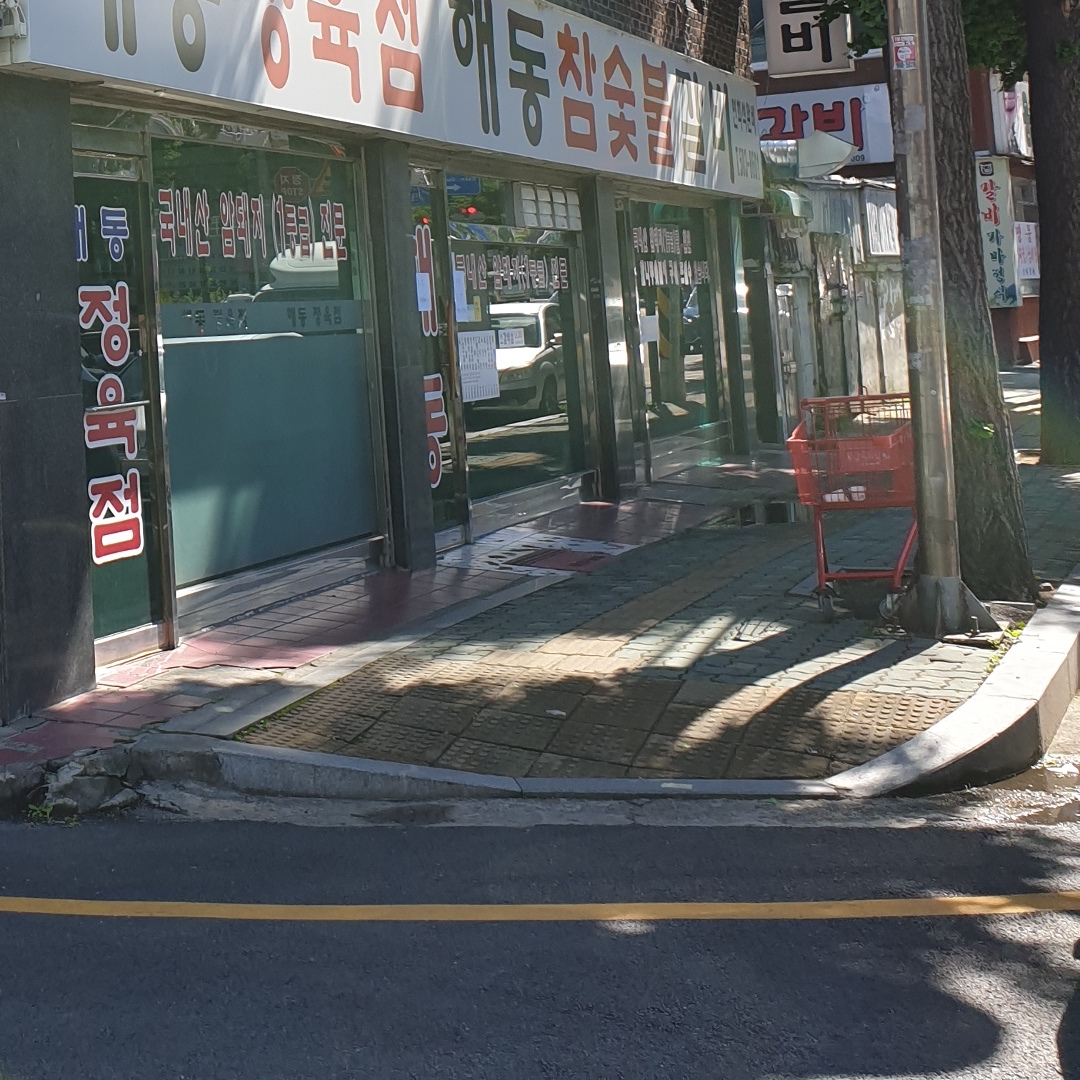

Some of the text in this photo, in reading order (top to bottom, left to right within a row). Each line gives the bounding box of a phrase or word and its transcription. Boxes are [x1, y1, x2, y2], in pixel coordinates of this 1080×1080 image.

[158, 187, 210, 258] 국내산
[319, 200, 348, 261] 전문
[78, 281, 145, 566] 정육점
